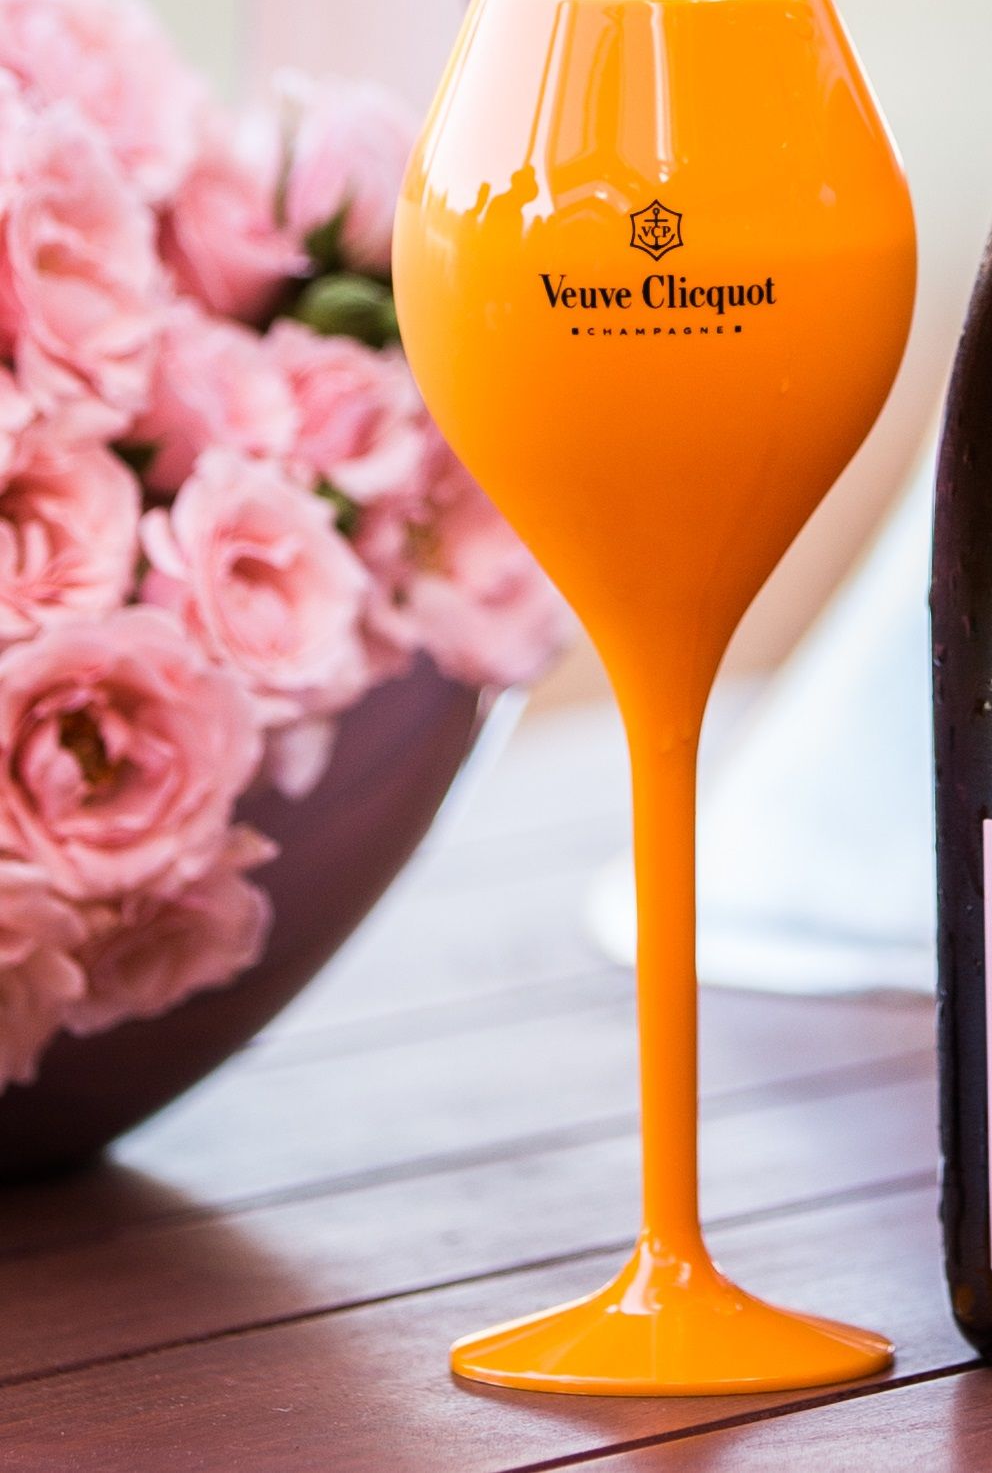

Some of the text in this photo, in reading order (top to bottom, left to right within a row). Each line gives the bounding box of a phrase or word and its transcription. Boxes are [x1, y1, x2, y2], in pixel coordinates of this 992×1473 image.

[538, 273, 776, 315] Veuve Clicquot
[587, 325, 724, 336] CHAMPAGNE
